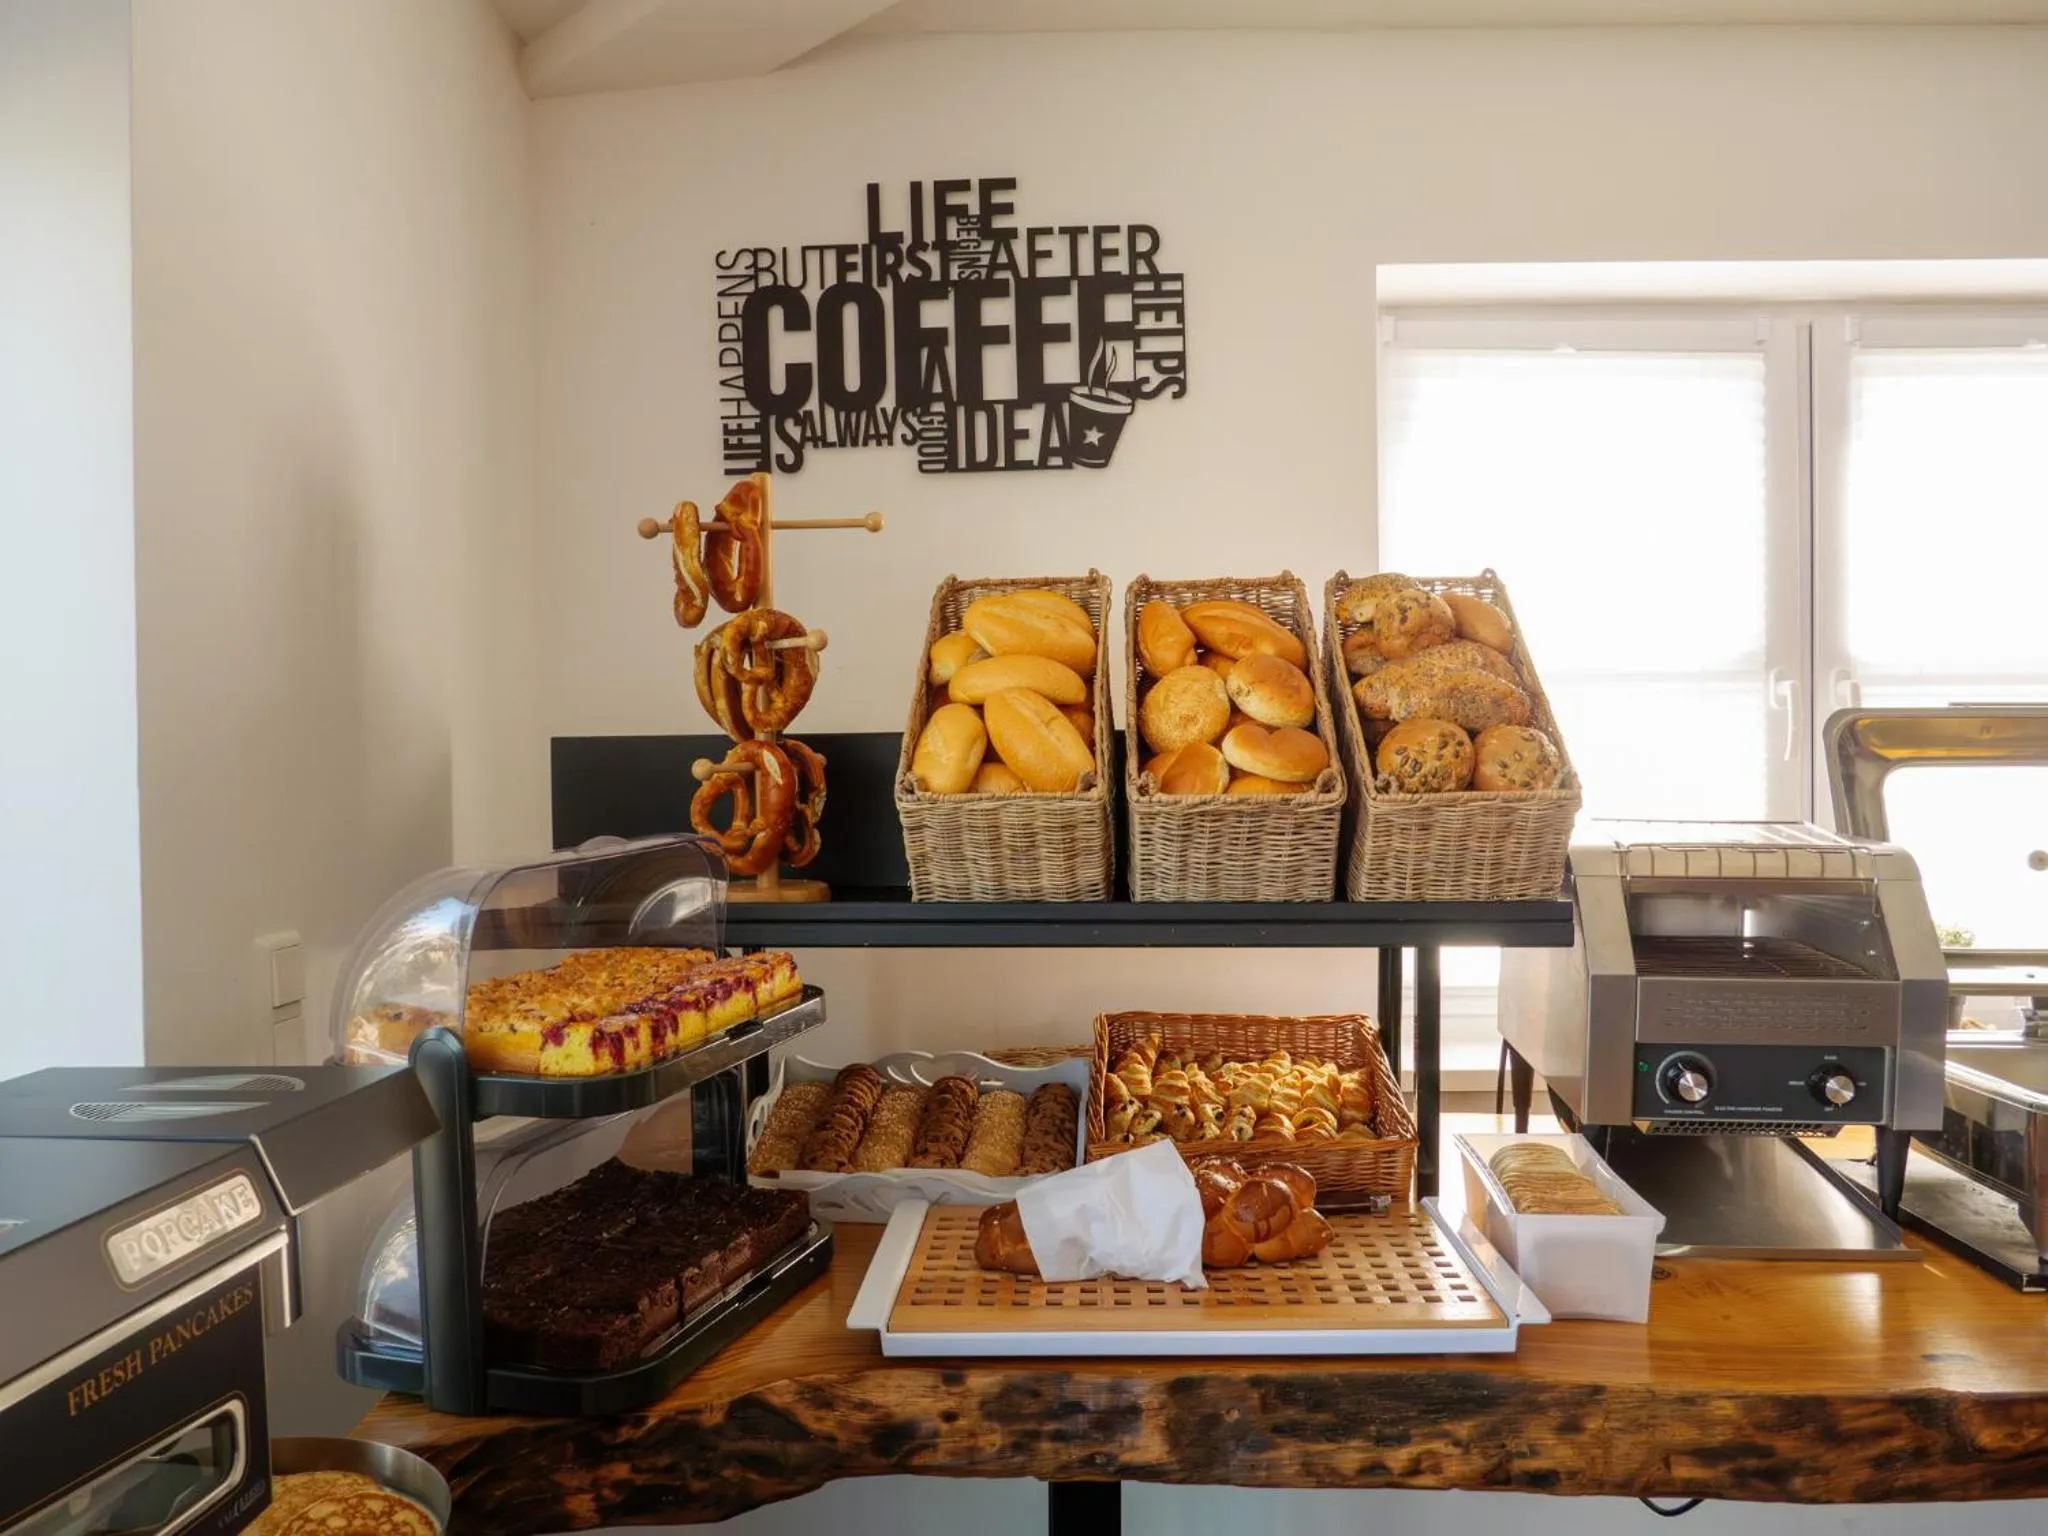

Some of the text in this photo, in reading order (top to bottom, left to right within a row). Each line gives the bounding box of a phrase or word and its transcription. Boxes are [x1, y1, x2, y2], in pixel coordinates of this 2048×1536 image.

[866, 177, 1017, 246] LIFE
[753, 241, 963, 291] BUT FIRST
[957, 214, 983, 282] BEGINS
[983, 224, 1161, 281] AFTER
[715, 248, 764, 475] LIFE HAPPENS
[741, 277, 1136, 415] COFFEE
[1131, 273, 1188, 400] HELPS
[759, 403, 920, 474] IS ALWAYS
[916, 404, 949, 474] GOOD
[948, 401, 1074, 473] IDEA
[66, 1282, 254, 1417] FRESH PANCAKES
